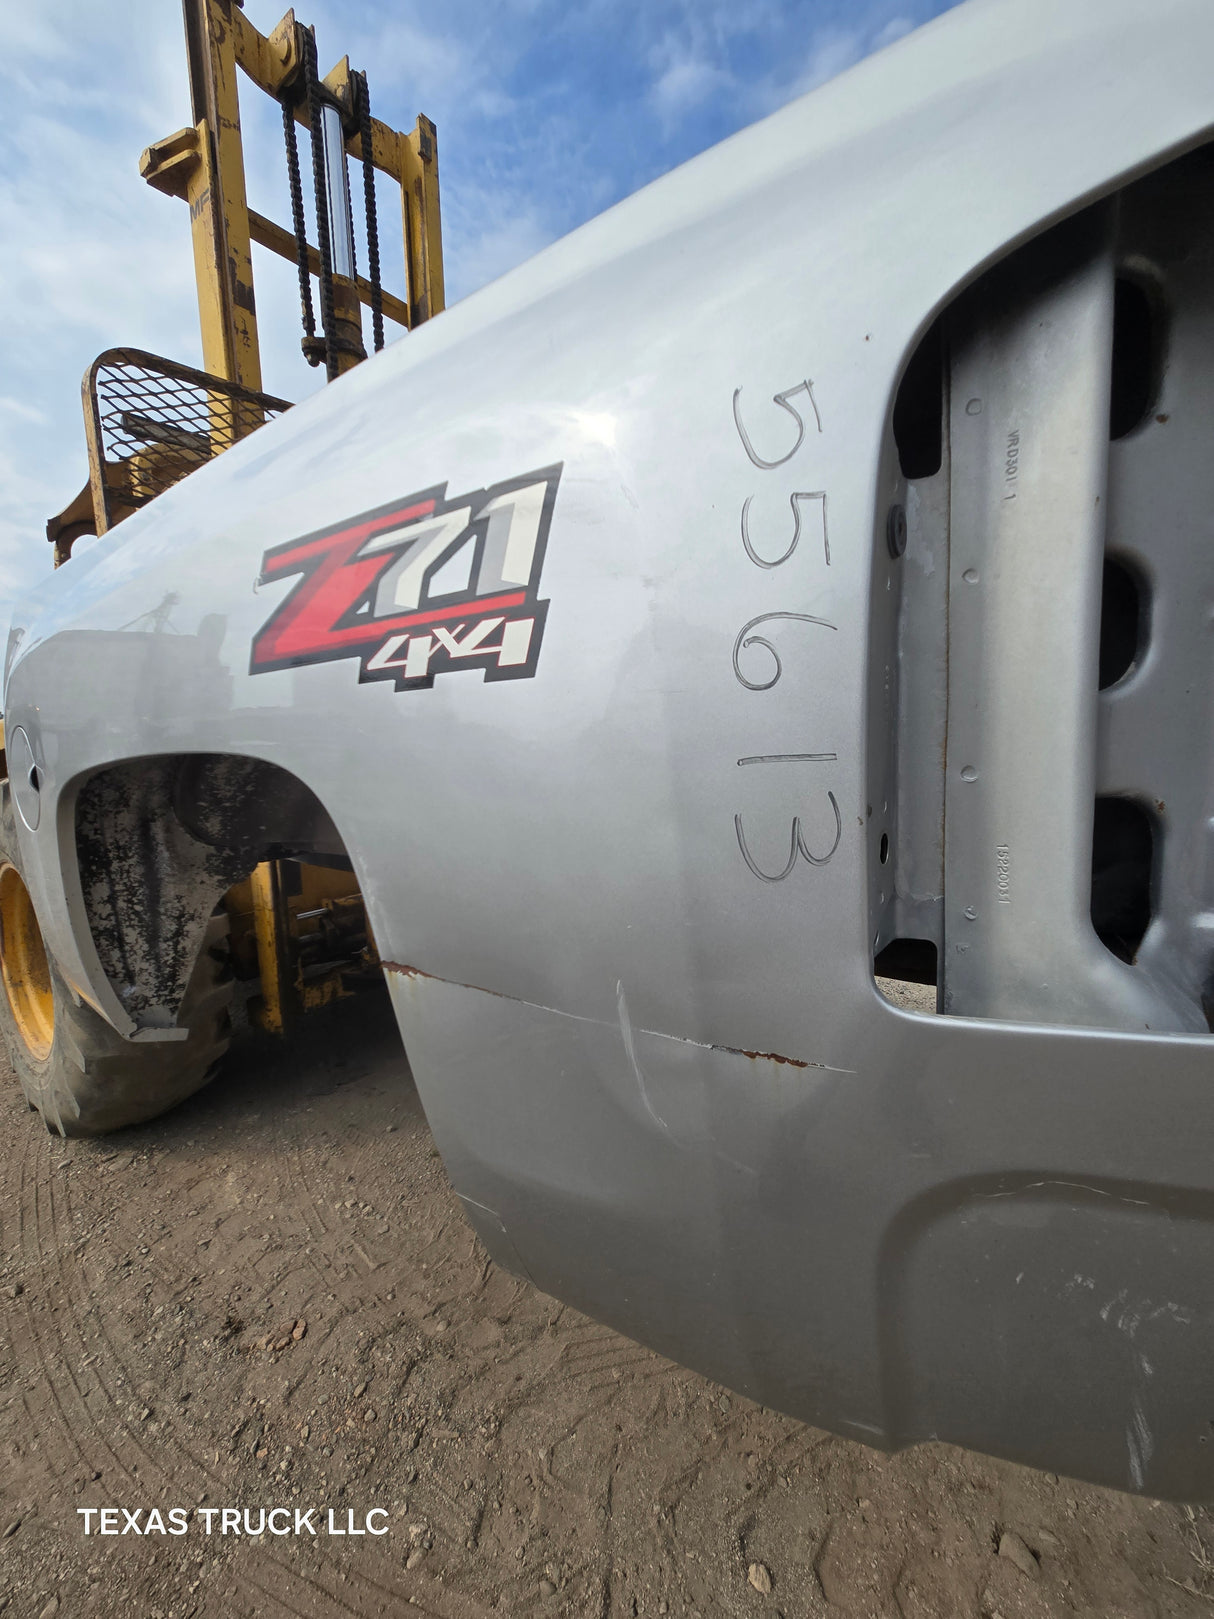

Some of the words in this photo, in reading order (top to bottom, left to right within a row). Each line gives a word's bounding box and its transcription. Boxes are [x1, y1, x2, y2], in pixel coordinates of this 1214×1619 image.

[189, 188, 211, 225] MF
[252, 474, 552, 666] Z71
[732, 378, 842, 883] 55613
